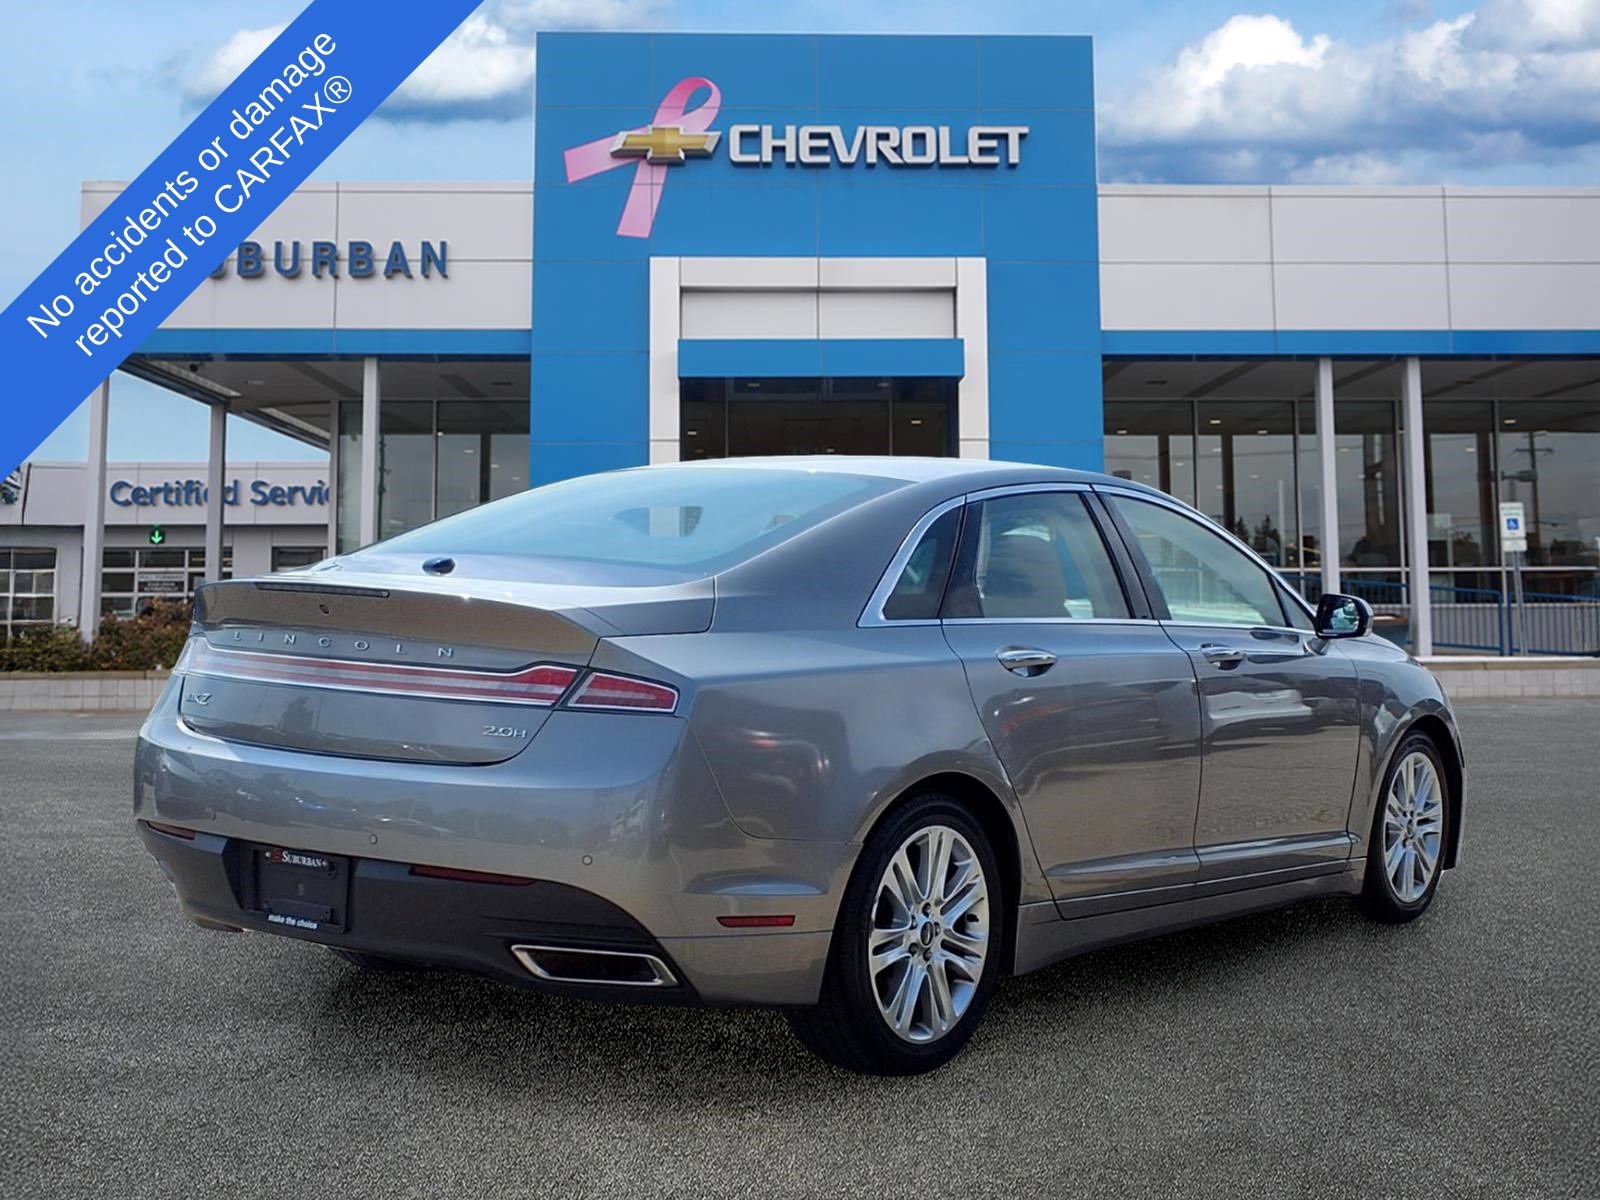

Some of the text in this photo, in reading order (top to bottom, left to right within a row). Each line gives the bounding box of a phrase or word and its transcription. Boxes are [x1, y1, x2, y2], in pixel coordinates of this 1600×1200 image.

[729, 124, 1029, 166] CHEVROLET
[209, 240, 449, 279] BURBAN
[110, 479, 240, 506] Certifid
[232, 630, 454, 658] LINCOLN
[482, 725, 526, 738] 2.0H
[268, 914, 318, 930] make the choice
